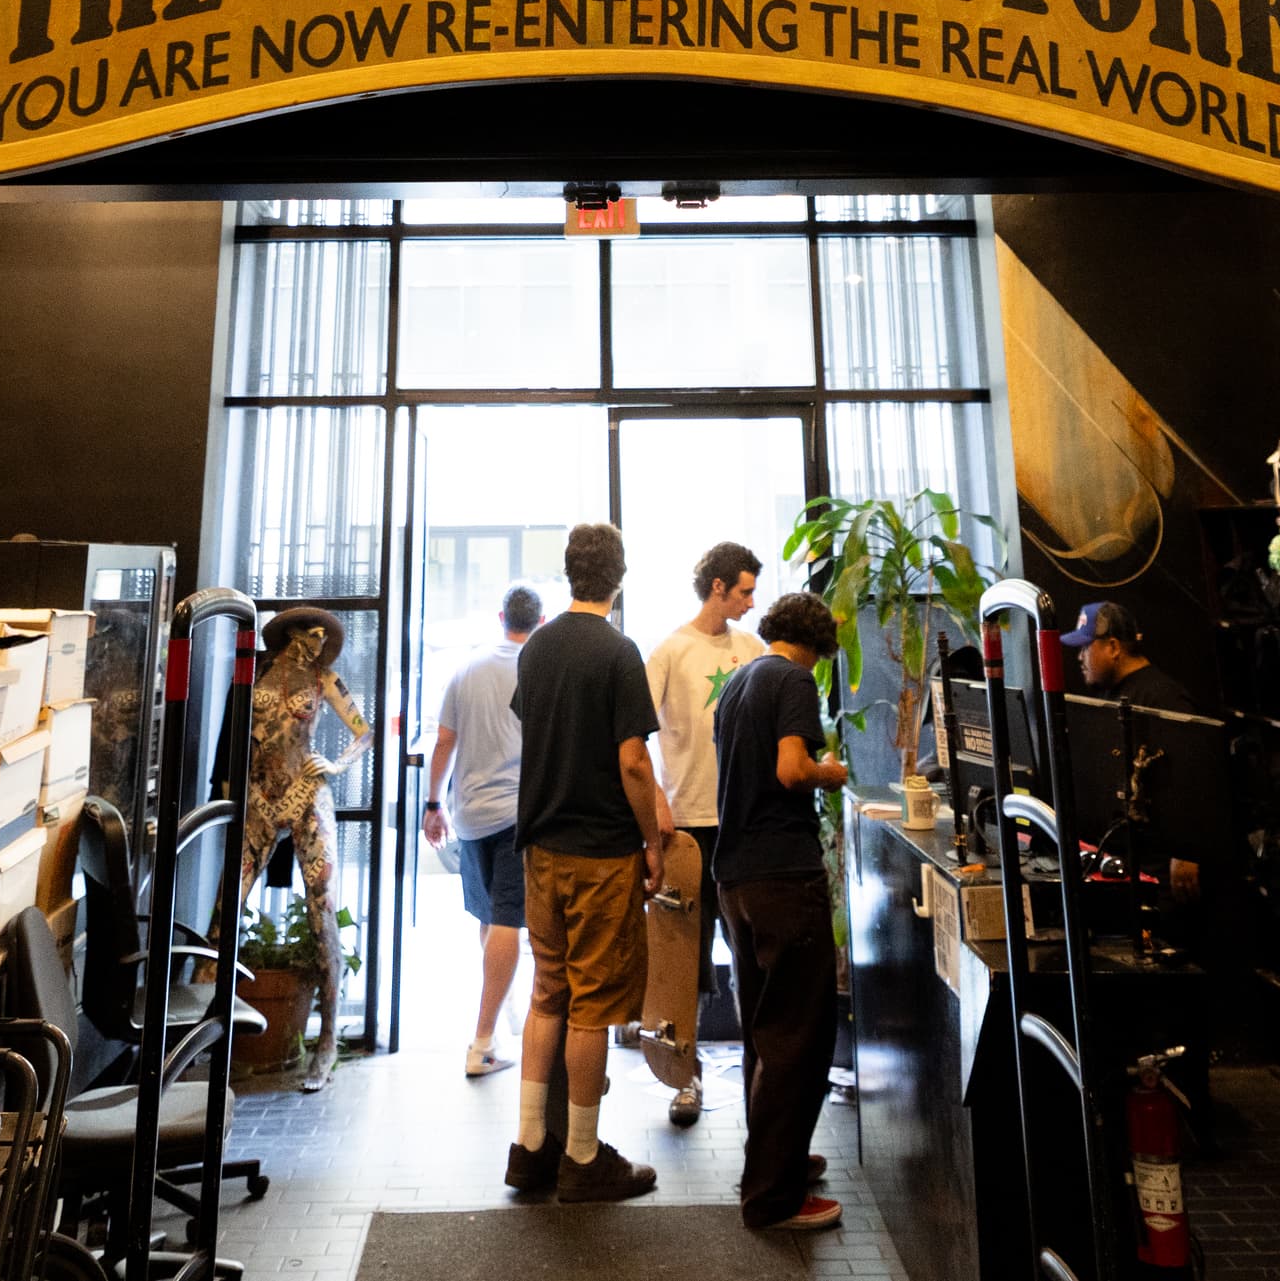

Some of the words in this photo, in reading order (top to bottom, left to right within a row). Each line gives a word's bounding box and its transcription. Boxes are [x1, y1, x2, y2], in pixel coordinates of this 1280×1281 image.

[119, 31, 232, 108] ARE
[249, 3, 412, 80] NOW
[808, 3, 920, 70] THE
[940, 21, 1077, 100] REAL
